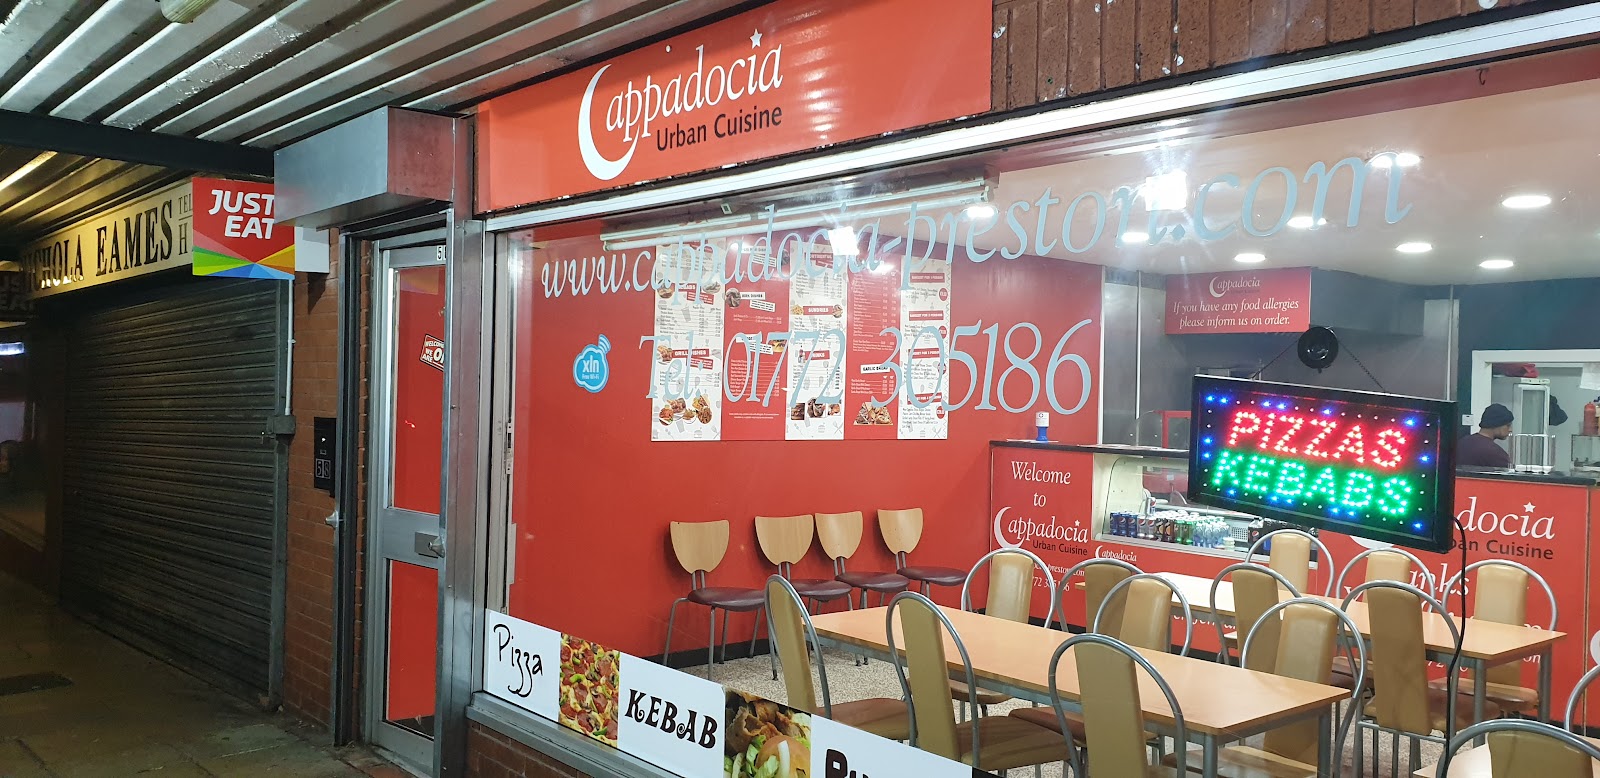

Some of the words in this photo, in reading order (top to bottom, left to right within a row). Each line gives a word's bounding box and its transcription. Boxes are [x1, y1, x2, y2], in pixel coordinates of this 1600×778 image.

[578, 29, 784, 181] Cappadocia
[656, 123, 707, 152] Urban
[714, 104, 783, 139] Cuisine
[208, 189, 275, 216] JUST
[95, 199, 173, 277] EAMES
[224, 215, 275, 240] EAT
[541, 151, 1415, 306] www.cappadocia-preston.com
[1209, 276, 1261, 298] Cappadocia
[1173, 301, 1181, 315] If
[1181, 303, 1198, 314] you
[1199, 300, 1220, 312] have
[1221, 301, 1239, 314] any
[1239, 298, 1261, 313] food
[1262, 297, 1299, 312] allergies
[1179, 316, 1205, 329] please
[1206, 314, 1236, 329] inform
[1239, 317, 1248, 326] us
[1250, 316, 1262, 326] on
[1263, 312, 1290, 325] order.
[424, 340, 445, 350] WELCOM
[638, 329, 704, 400] Tel:
[723, 328, 846, 408] 01772
[871, 317, 1093, 416] 305186
[1227, 409, 1407, 469] PIZZAS
[316, 459, 330, 478] 58
[1010, 460, 1071, 485] Welcome
[1213, 449, 1413, 516] KEBABS
[1033, 491, 1046, 508] to
[994, 506, 1088, 548] Cappadocia
[1032, 540, 1057, 552] Urban
[1058, 543, 1088, 556] Cuisine
[1485, 539, 1554, 559] Cuisine
[493, 623, 544, 698] Pizza
[624, 688, 719, 749] KEBAB
